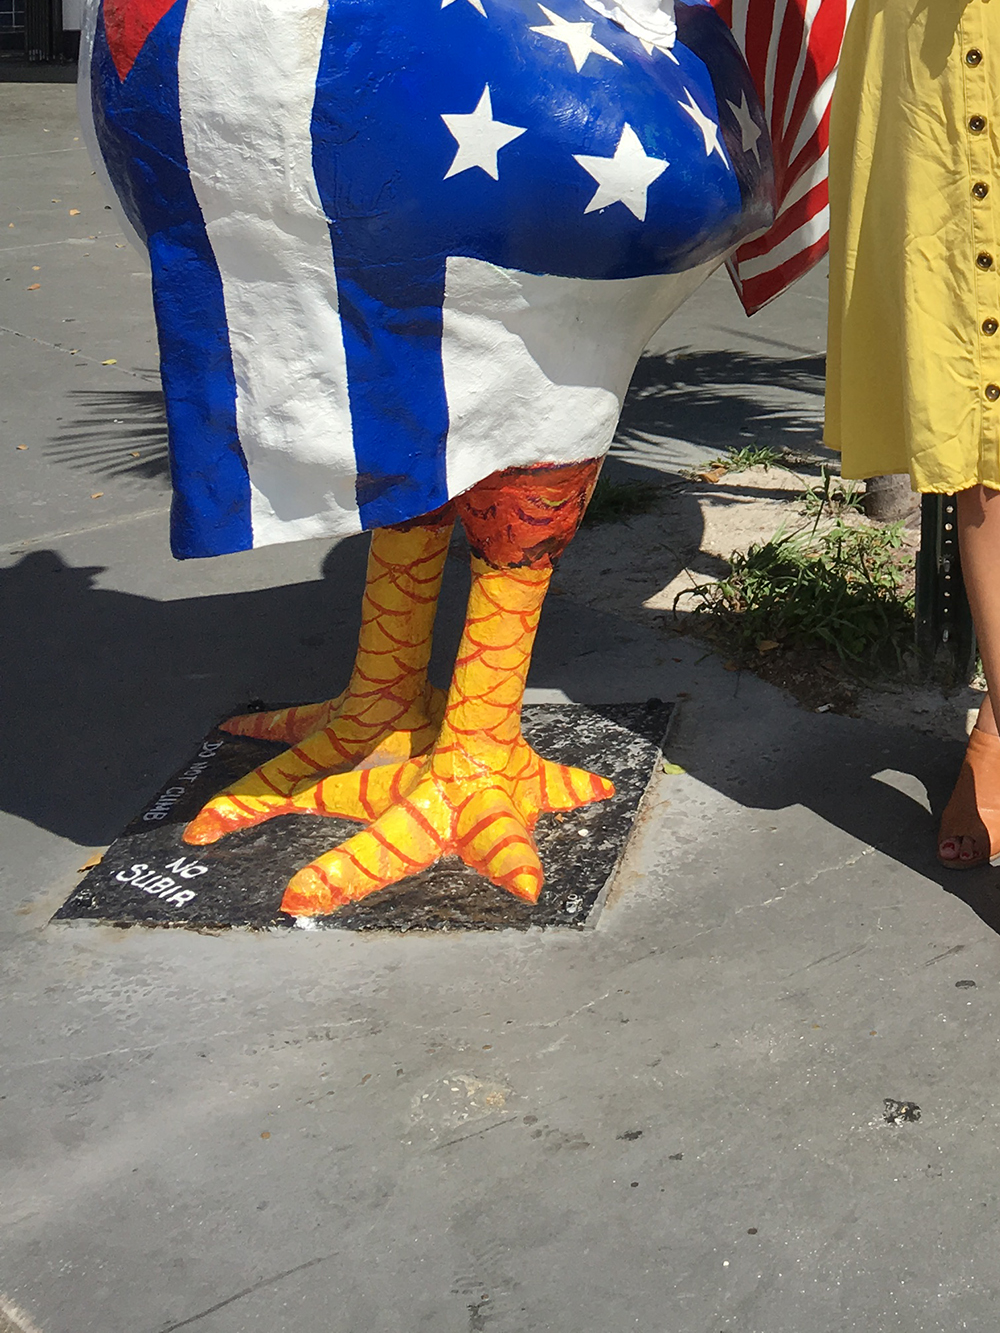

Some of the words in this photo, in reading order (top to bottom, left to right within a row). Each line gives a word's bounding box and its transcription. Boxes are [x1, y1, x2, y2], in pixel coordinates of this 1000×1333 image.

[198, 740, 224, 758] DO
[143, 786, 185, 821] CLIMB
[165, 857, 208, 879] NO
[116, 863, 196, 907] SUBIR
